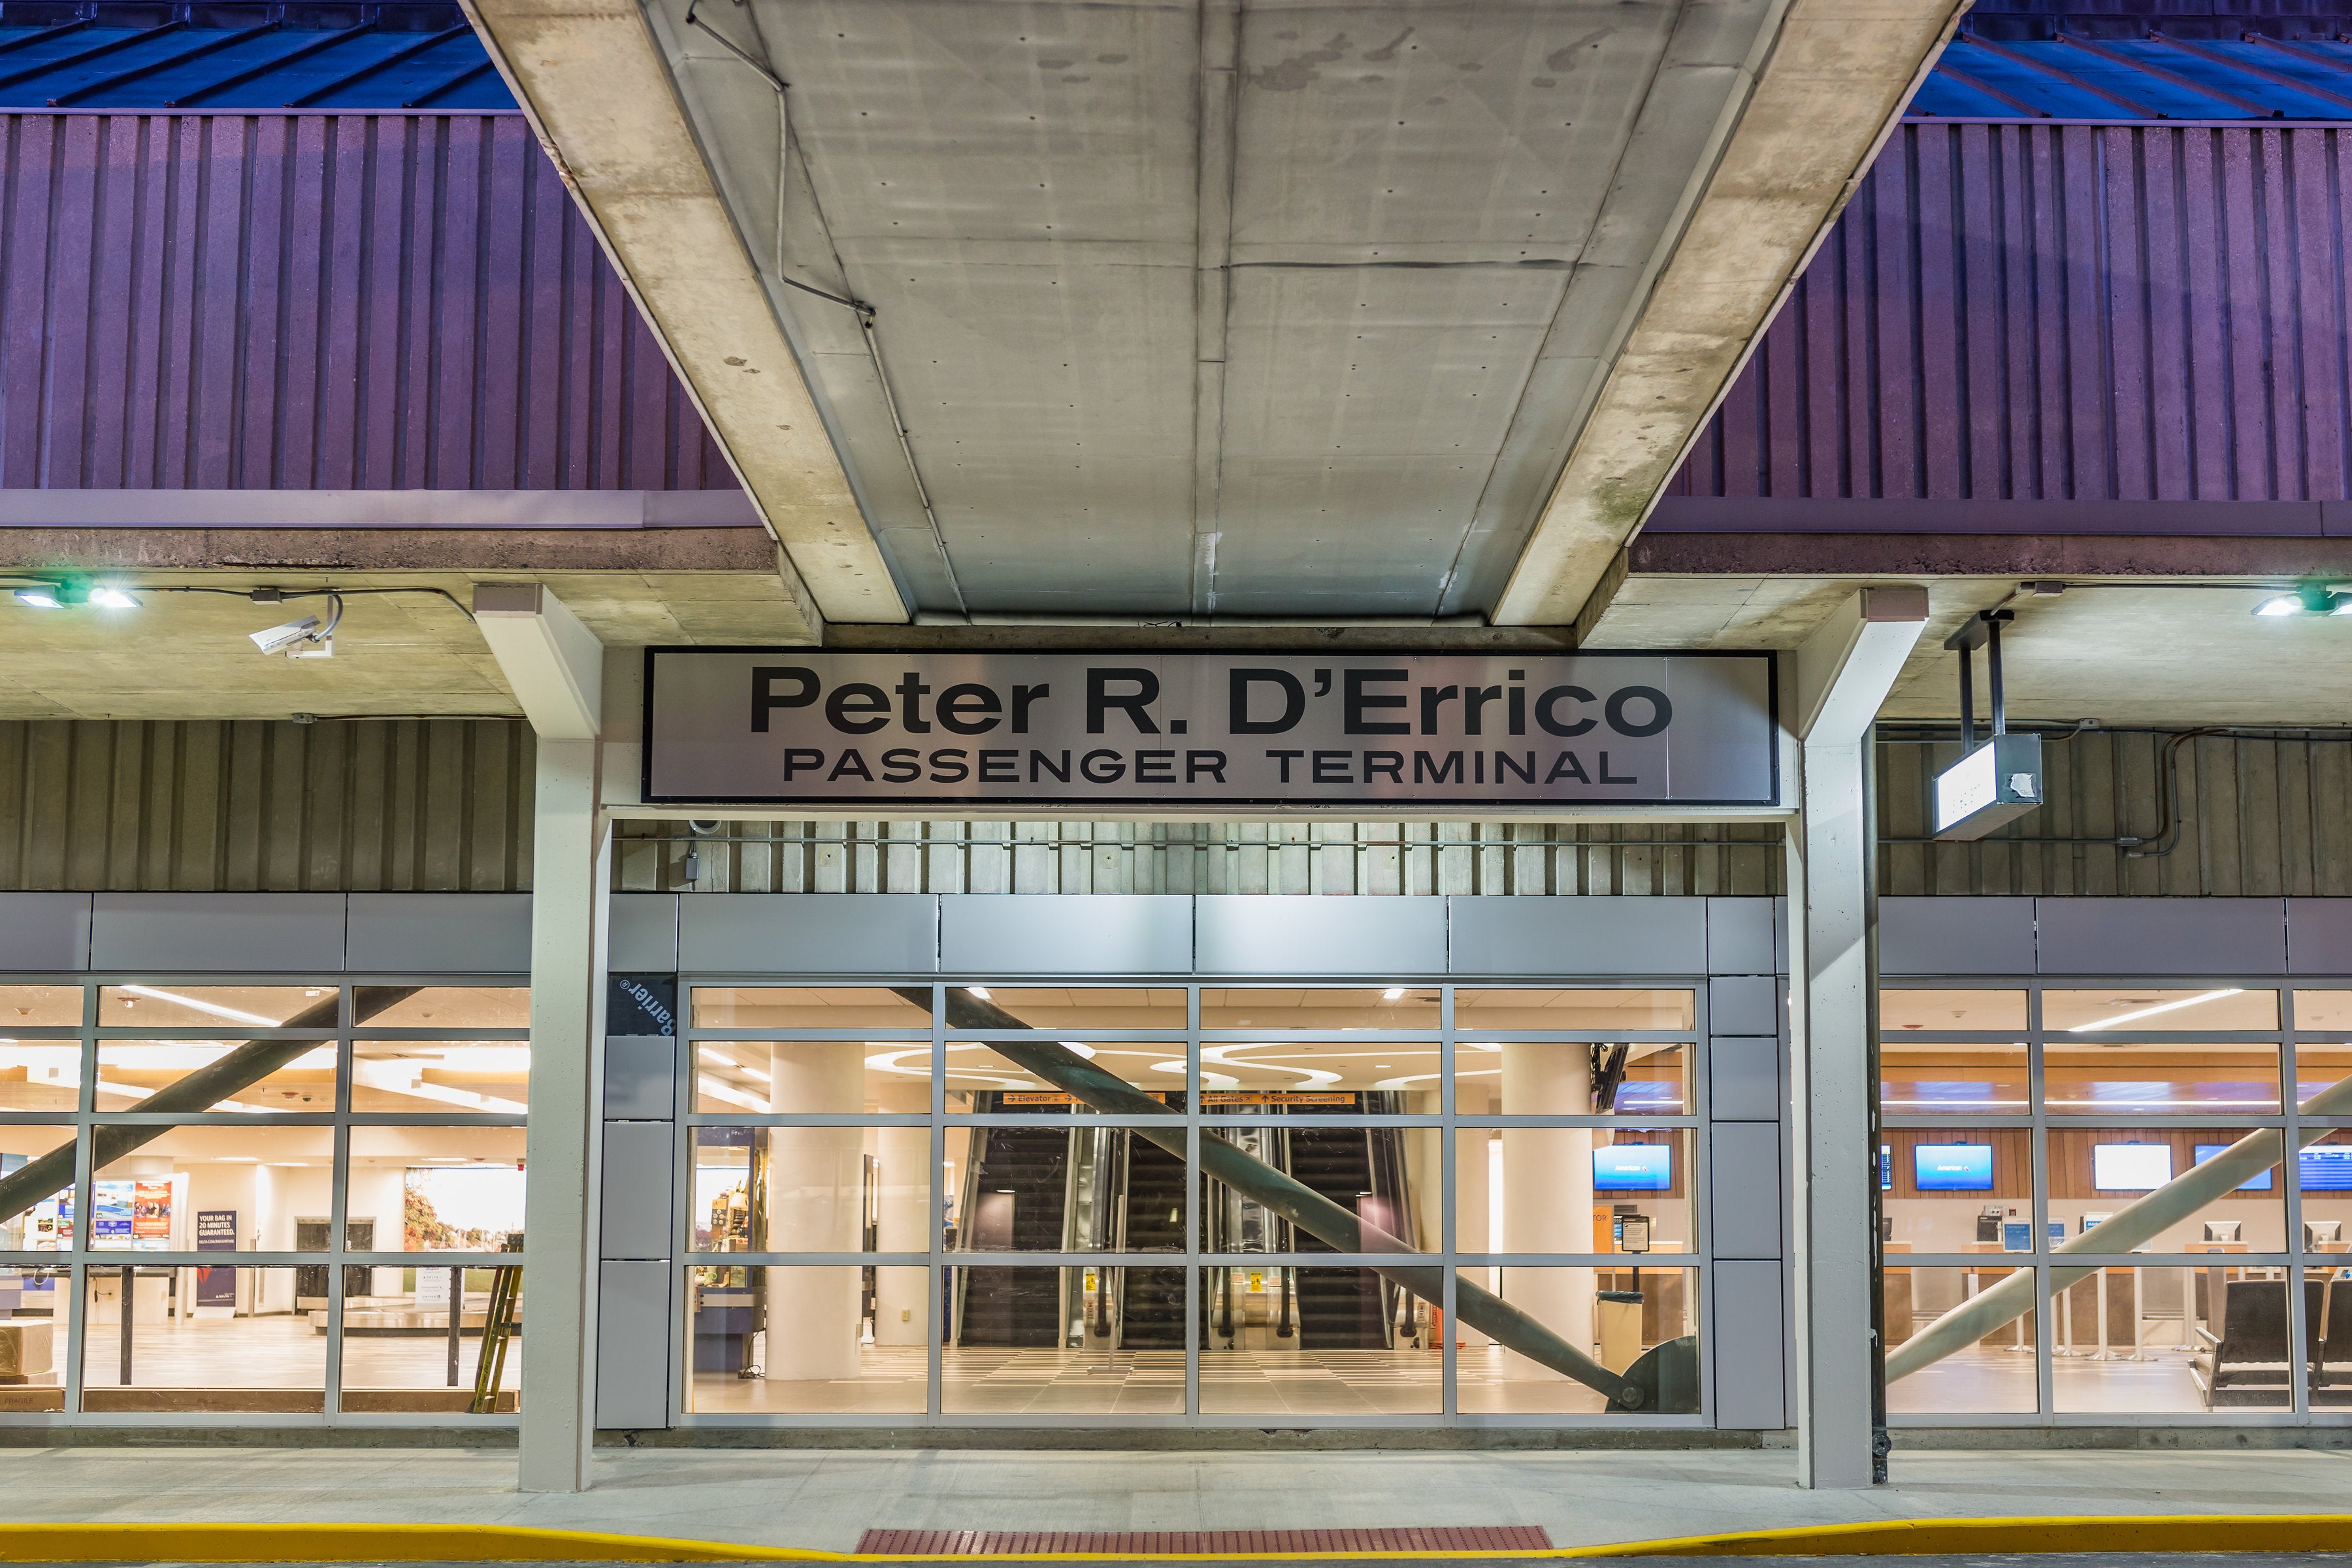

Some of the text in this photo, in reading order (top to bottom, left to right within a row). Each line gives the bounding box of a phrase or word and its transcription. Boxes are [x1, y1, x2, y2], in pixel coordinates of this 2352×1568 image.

[751, 666, 1673, 737] Peter R. D'Errico
[784, 748, 1638, 784] PASSENGER TERMINAL
[1271, 1095, 1345, 1103] Security Screening
